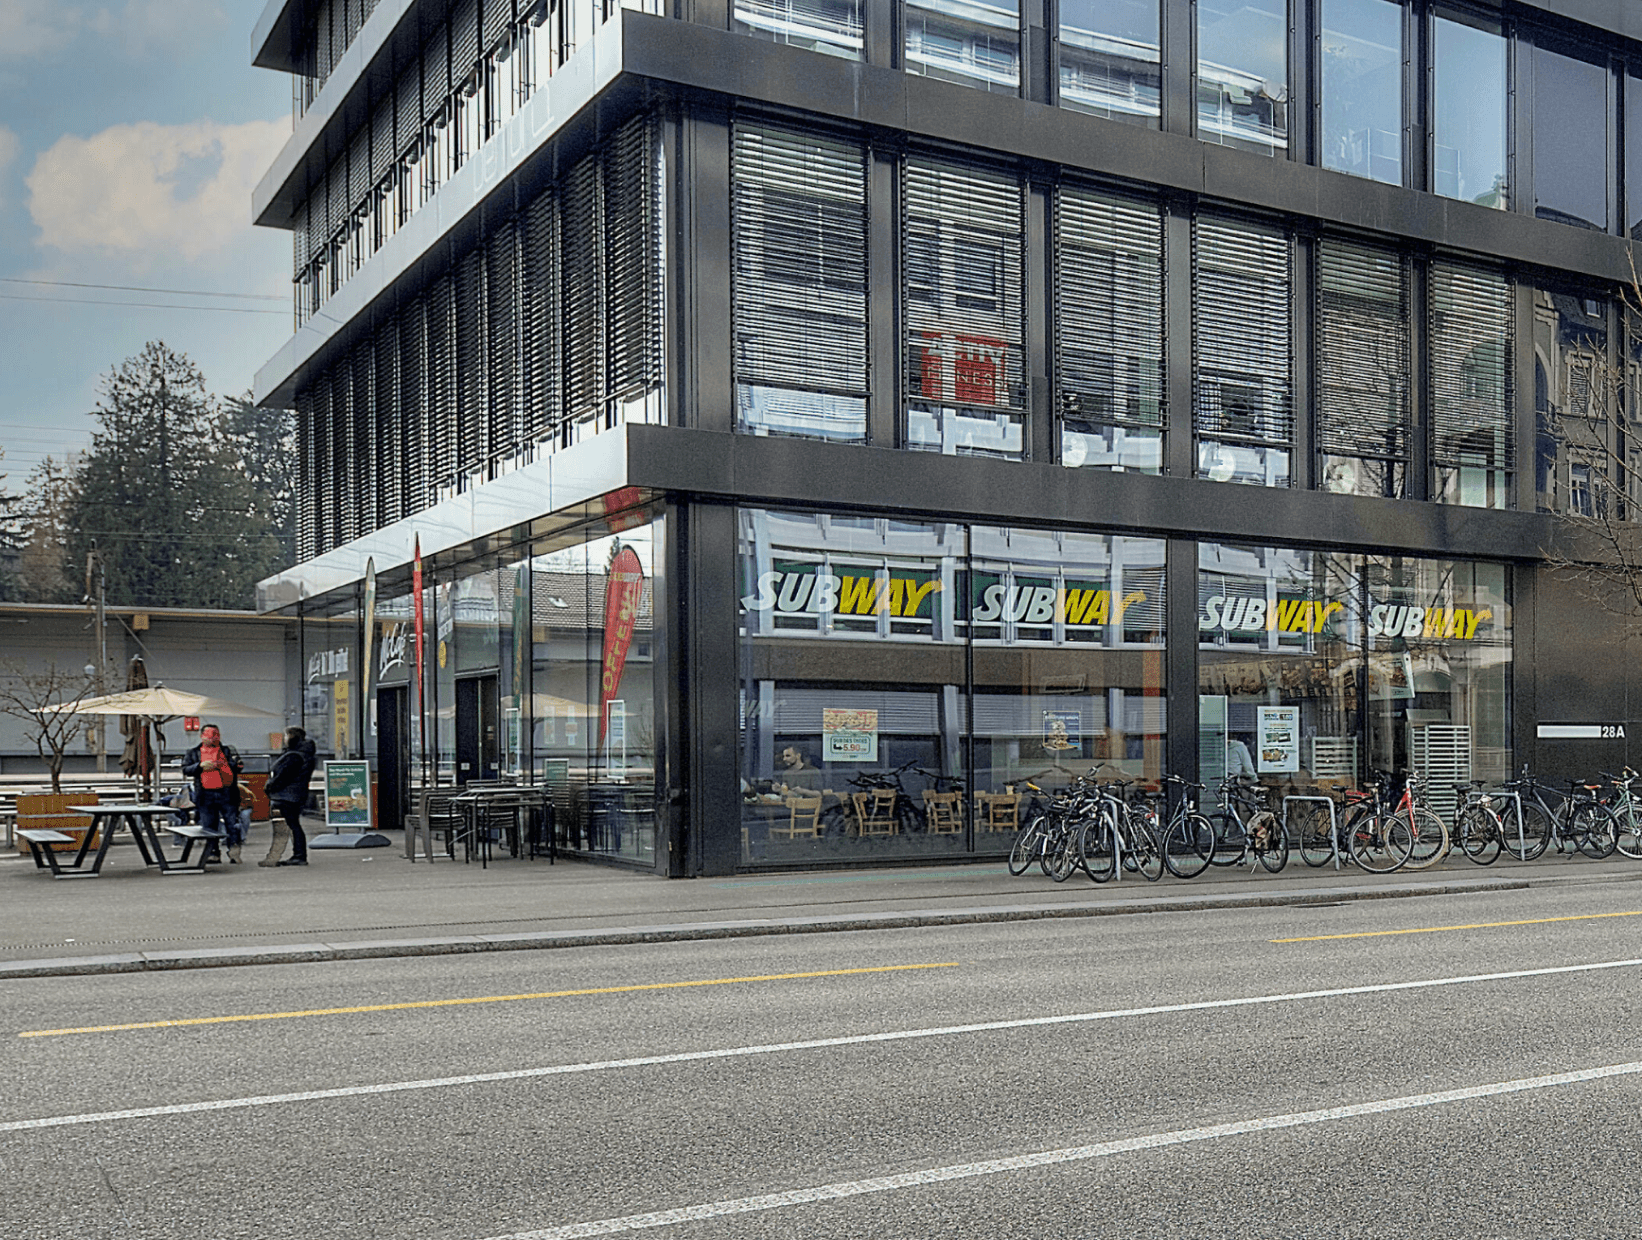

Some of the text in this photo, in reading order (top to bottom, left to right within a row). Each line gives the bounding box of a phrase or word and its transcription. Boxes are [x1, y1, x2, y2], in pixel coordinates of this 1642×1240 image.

[927, 365, 1005, 388] FINESS
[740, 570, 947, 618] SUBWAY
[973, 583, 1147, 625] SUBWAY
[1199, 596, 1344, 633] SUBWAY
[1368, 604, 1493, 640] SUBWAY
[1602, 725, 1626, 739] 28A
